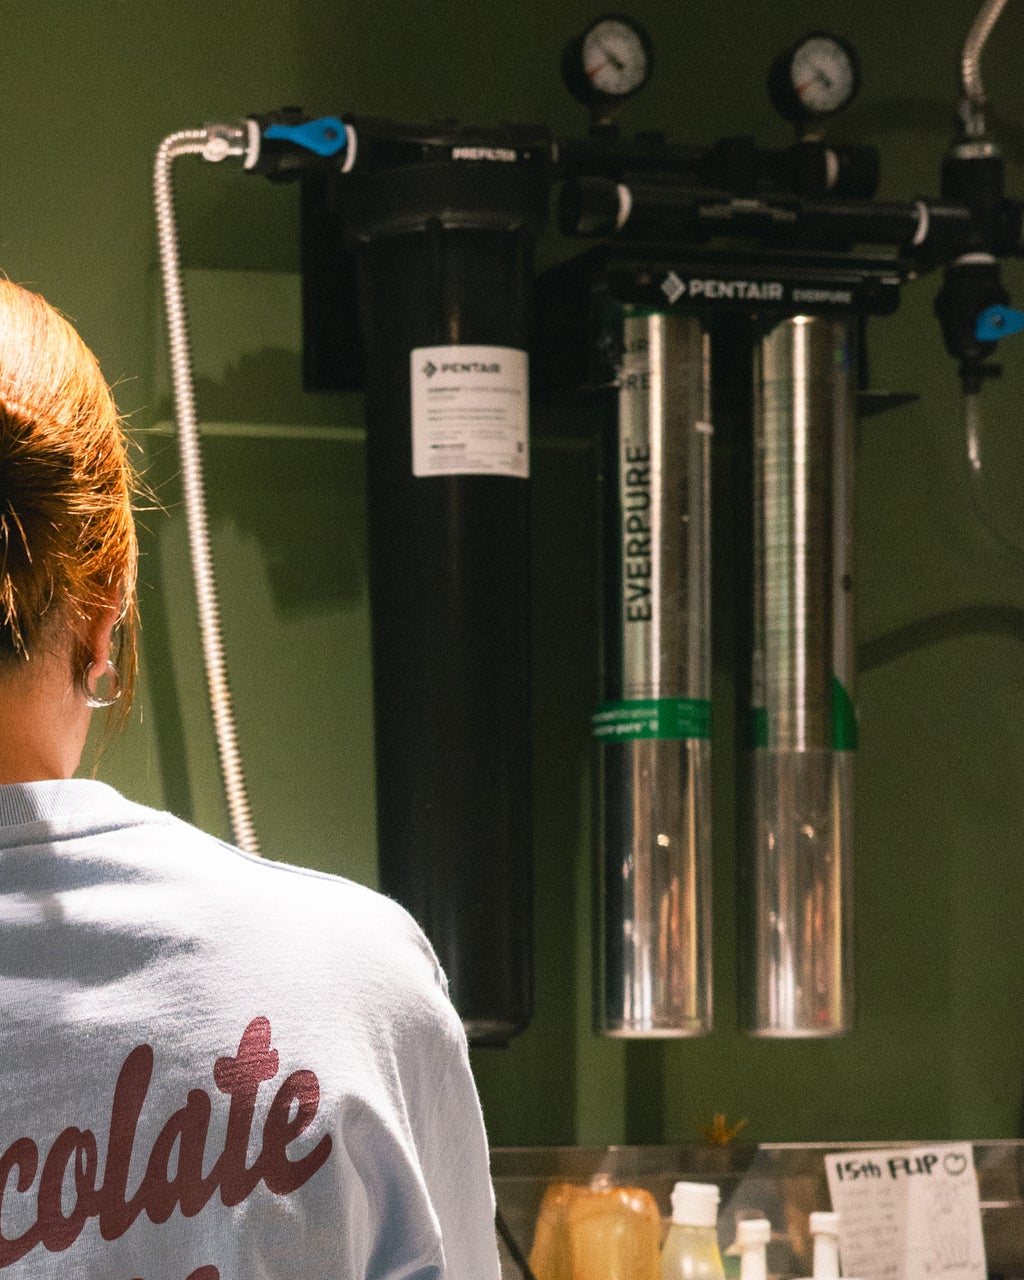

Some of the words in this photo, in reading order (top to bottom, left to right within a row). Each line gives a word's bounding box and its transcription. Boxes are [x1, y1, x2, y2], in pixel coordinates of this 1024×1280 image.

[688, 279, 784, 301] PENTAIR
[627, 446, 652, 623] EVERPURE
[887, 1153, 939, 1180] FLIP
